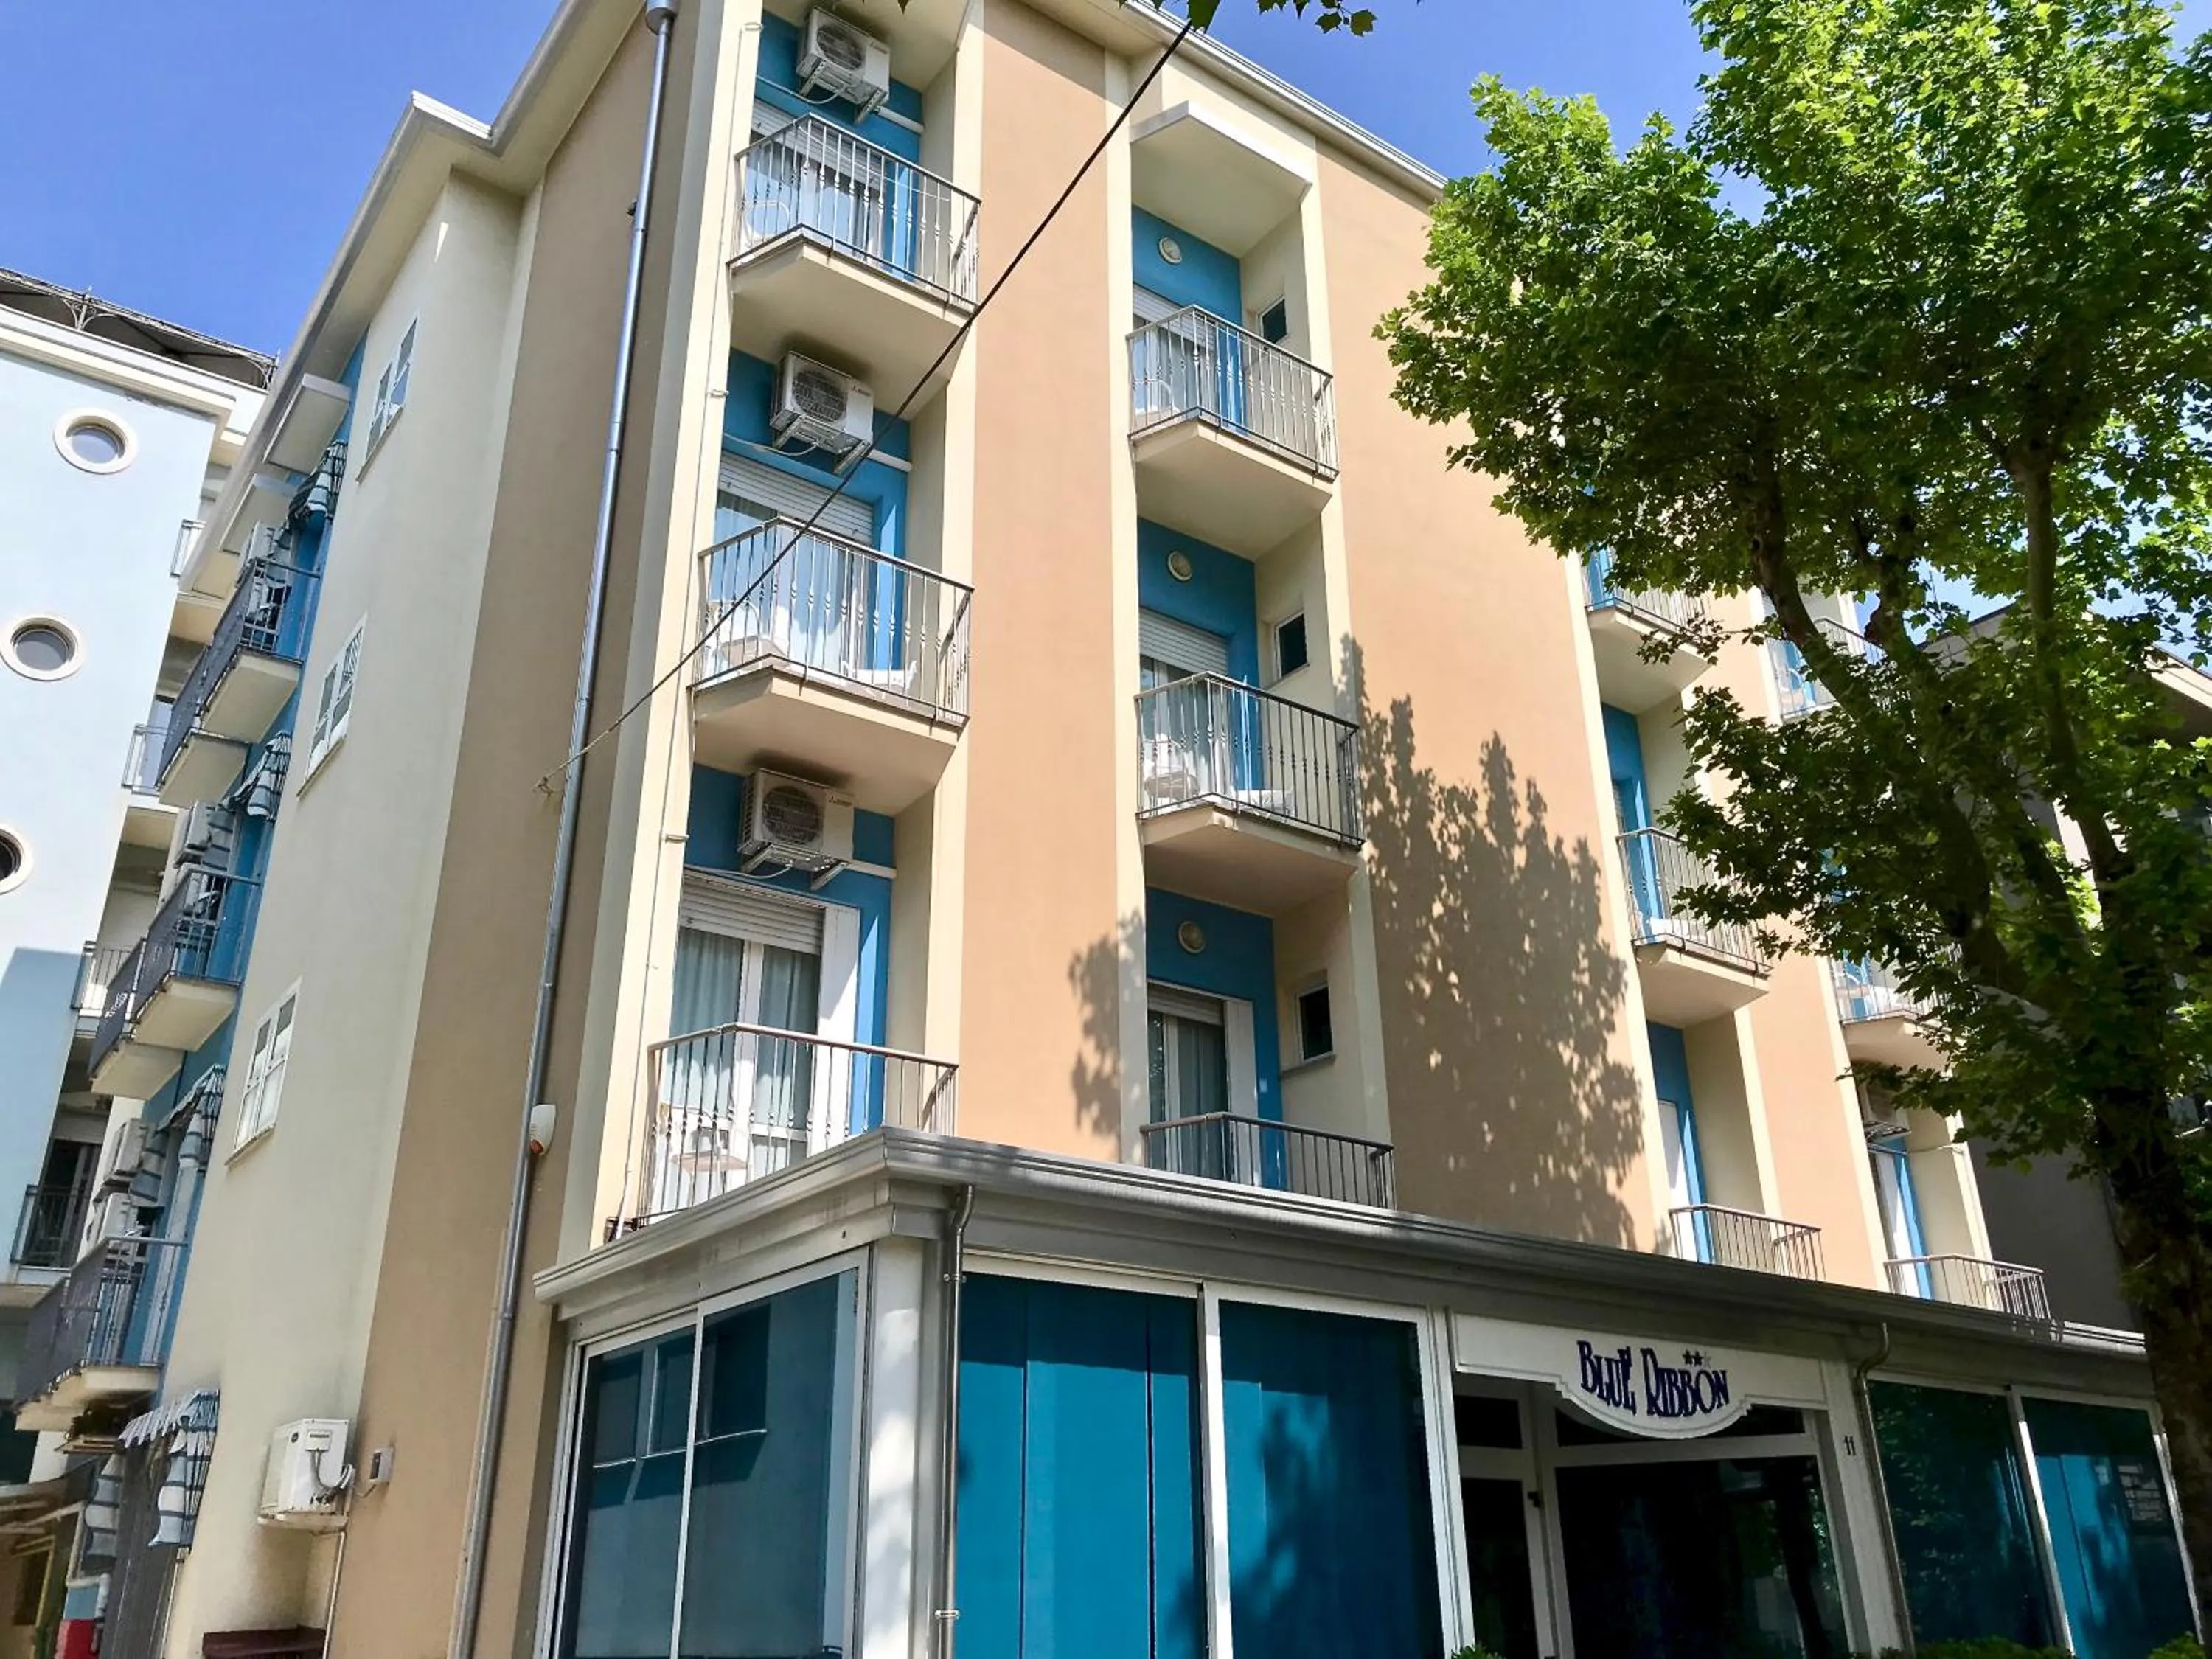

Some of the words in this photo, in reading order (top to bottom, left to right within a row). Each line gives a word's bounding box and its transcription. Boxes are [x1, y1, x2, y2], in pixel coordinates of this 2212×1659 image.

[1576, 1340, 1637, 1416] BLUE
[1640, 1347, 1730, 1417] RIBBON
[1844, 1436, 1856, 1456] 11
